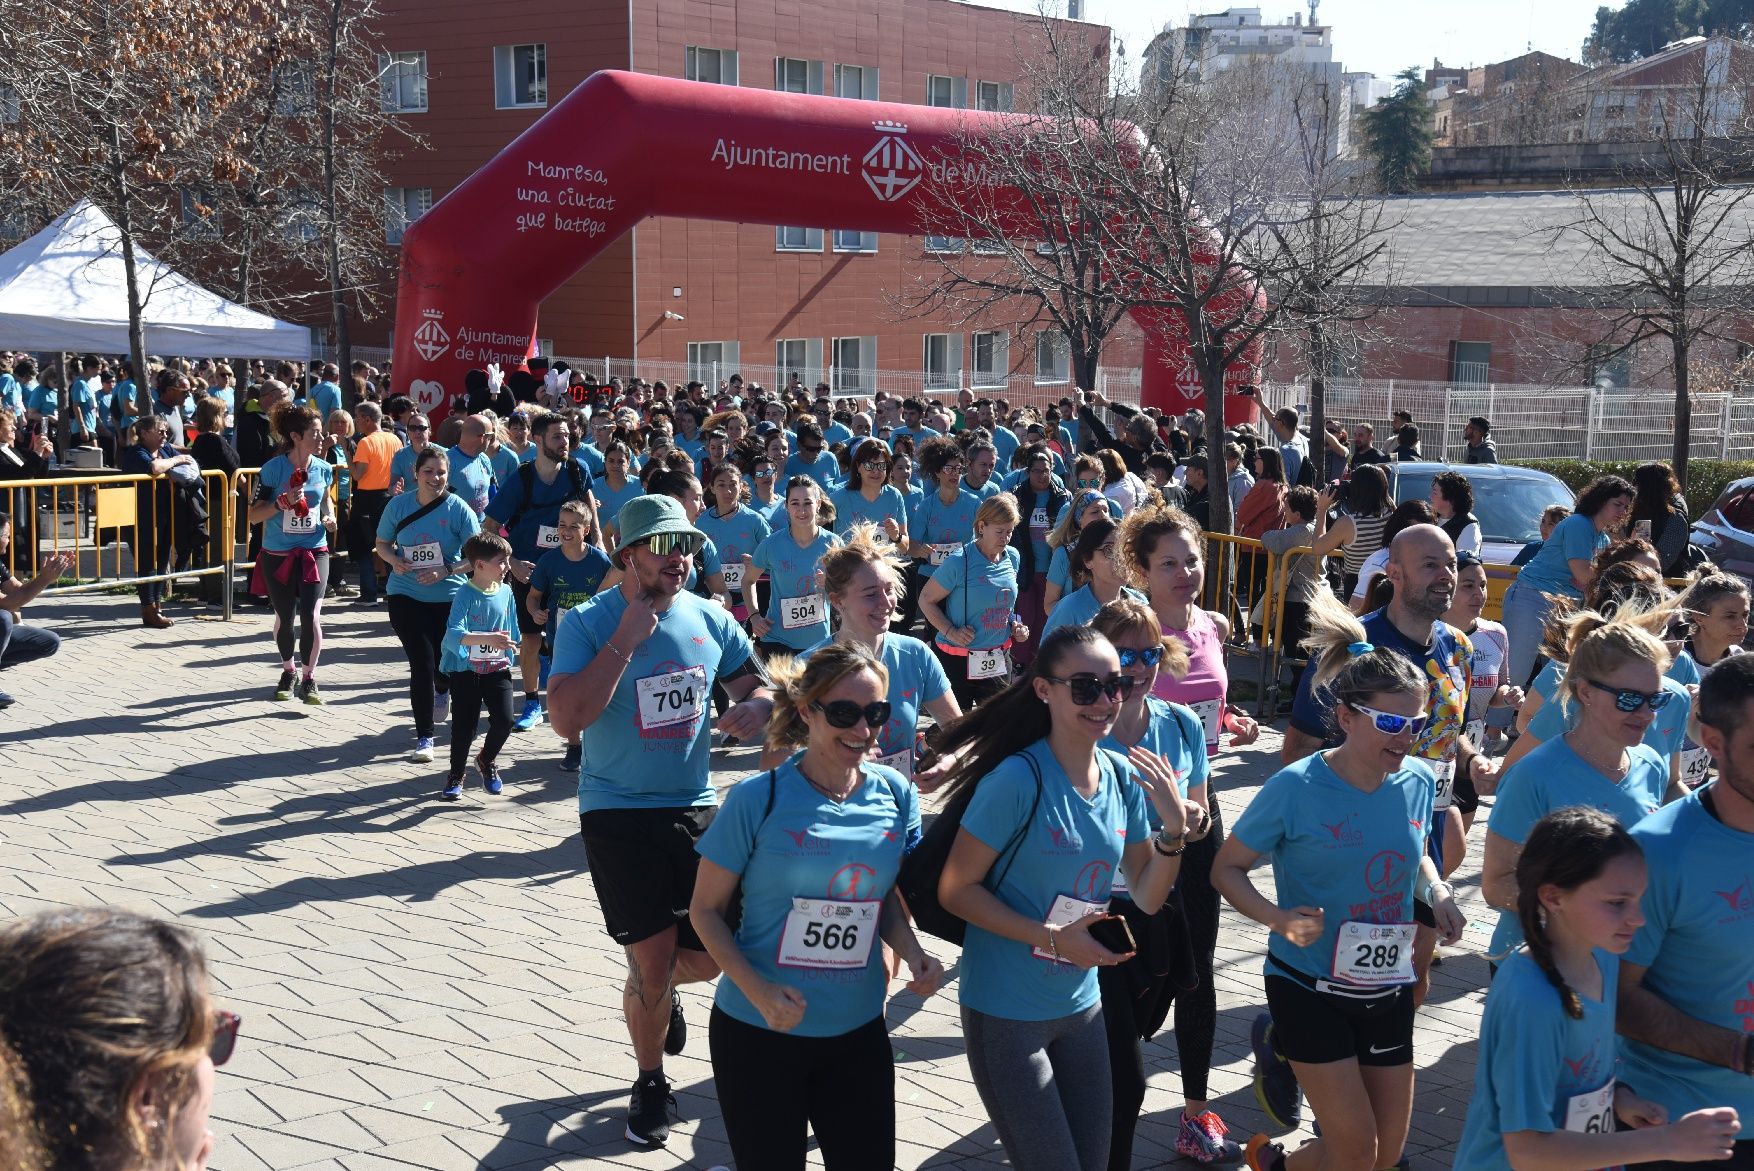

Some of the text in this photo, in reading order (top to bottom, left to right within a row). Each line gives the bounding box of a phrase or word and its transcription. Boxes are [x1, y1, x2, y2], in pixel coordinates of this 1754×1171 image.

[711, 138, 851, 175] Ajuntament
[527, 160, 608, 186] Manresa,
[517, 187, 616, 211] una ciutat
[516, 212, 606, 238] que batega
[456, 326, 529, 347] Ajuntament
[455, 345, 475, 360] de
[479, 348, 527, 365] Manresa
[291, 516, 312, 528] 515
[545, 533, 560, 543] 66
[412, 550, 435, 562] 899
[937, 550, 955, 560] 73
[724, 572, 739, 583] 82
[791, 604, 816, 620] 504
[981, 659, 996, 671] 39
[653, 685, 695, 713] 704
[803, 921, 859, 951] 566
[1354, 944, 1399, 968] 289
[1585, 1106, 1612, 1134] 60
